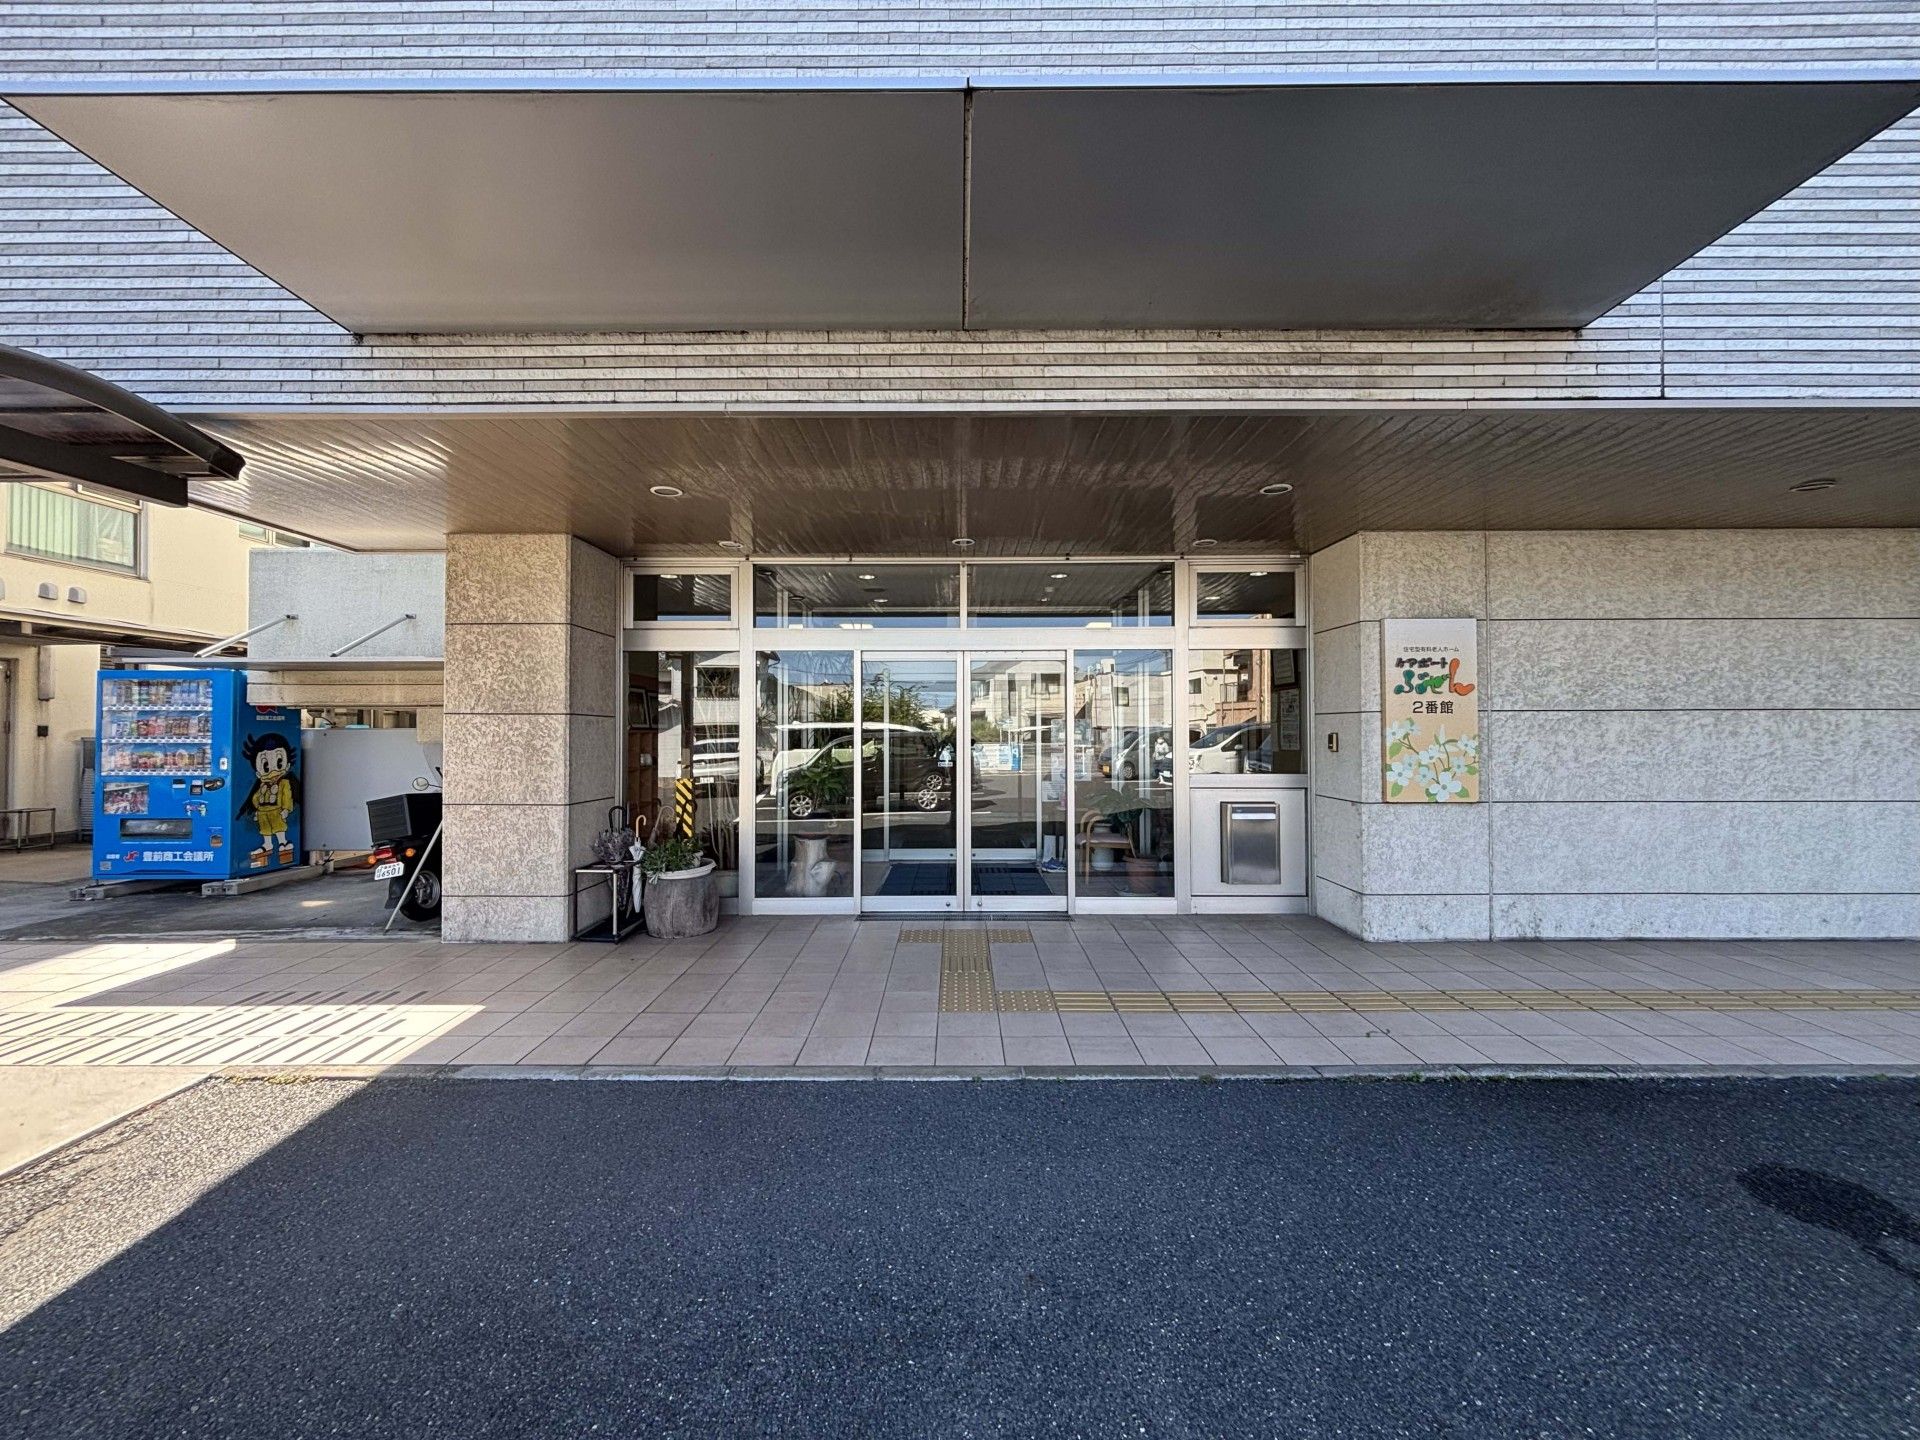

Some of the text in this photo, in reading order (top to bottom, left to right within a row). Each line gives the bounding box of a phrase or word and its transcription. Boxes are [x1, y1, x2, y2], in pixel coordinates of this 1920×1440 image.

[1412, 700, 1454, 714] 2番館
[142, 851, 214, 862] 豊前商工会議所
